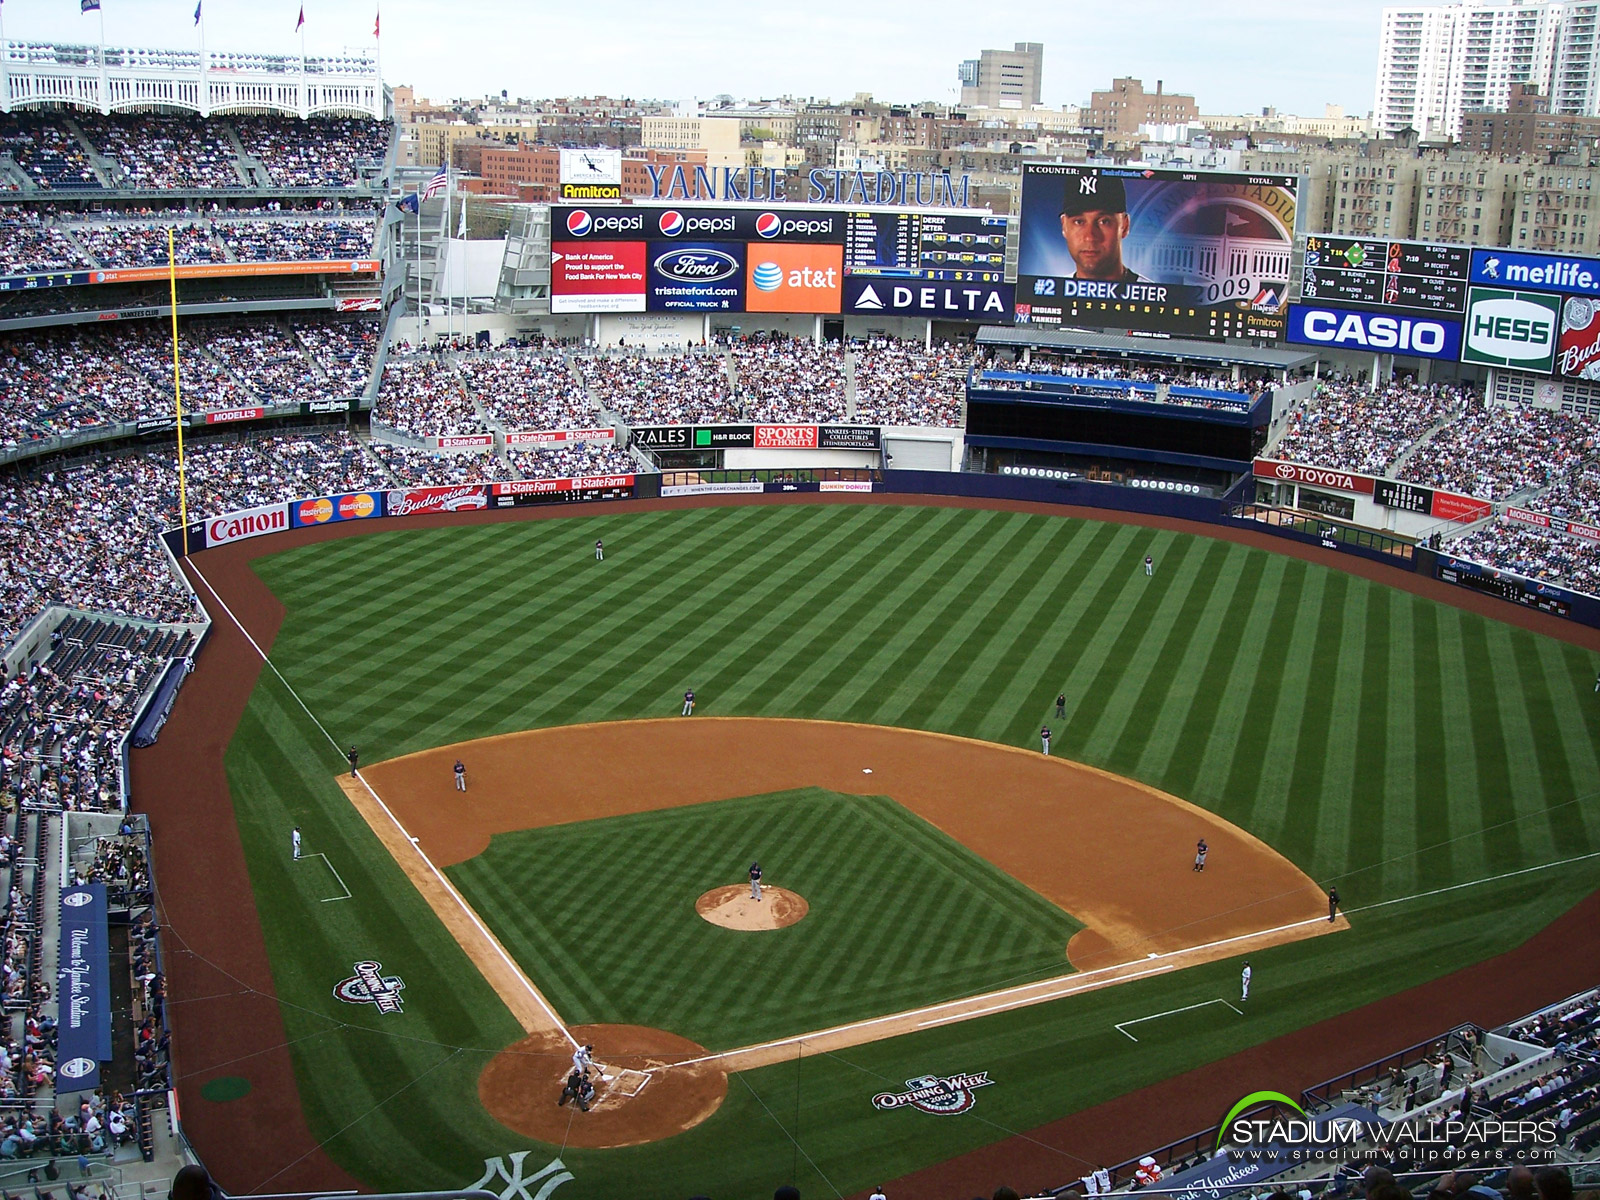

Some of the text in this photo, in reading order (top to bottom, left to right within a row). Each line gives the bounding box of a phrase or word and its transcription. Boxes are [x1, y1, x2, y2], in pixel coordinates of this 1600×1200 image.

[564, 185, 619, 197] Armitron
[643, 164, 971, 208] YANKEE STADIUM
[594, 215, 643, 232] pepsi
[686, 216, 735, 233] pepsi
[783, 218, 833, 235] pepsi
[674, 255, 718, 276] Ford
[788, 266, 836, 289] at&t
[938, 271, 943, 279] 1
[655, 287, 737, 296] tristateford.com
[1034, 279, 1167, 302] #2 DEREK JETER
[894, 287, 1004, 312] DELTA
[1252, 304, 1280, 313] Majestic
[1248, 316, 1282, 327] Armitron
[1248, 329, 1277, 338] 3:55
[1304, 310, 1445, 353] CASIO
[1474, 315, 1550, 344] HESS
[309, 402, 349, 412] Poland Spring
[214, 410, 256, 422] MODELL'S
[138, 419, 171, 429] Amtrak.com
[637, 430, 685, 443] ZALES
[758, 428, 814, 439] SPORTS
[1298, 468, 1354, 489] TOYOTA
[1396, 484, 1412, 493] THE
[392, 486, 473, 516] Budweiser
[1383, 489, 1424, 504] SHARPER
[1388, 498, 1416, 510] IMAGE
[300, 506, 333, 517] MasterCard
[339, 502, 374, 512] MasterCard
[1509, 510, 1546, 524] MODELL'S
[210, 510, 285, 542] Canon
[71, 928, 88, 962] Welcome
[62, 965, 90, 994] Yankee
[70, 994, 90, 1028] Stadium
[929, 1093, 952, 1103] 2009
[1194, 1164, 1259, 1198] Yankees
